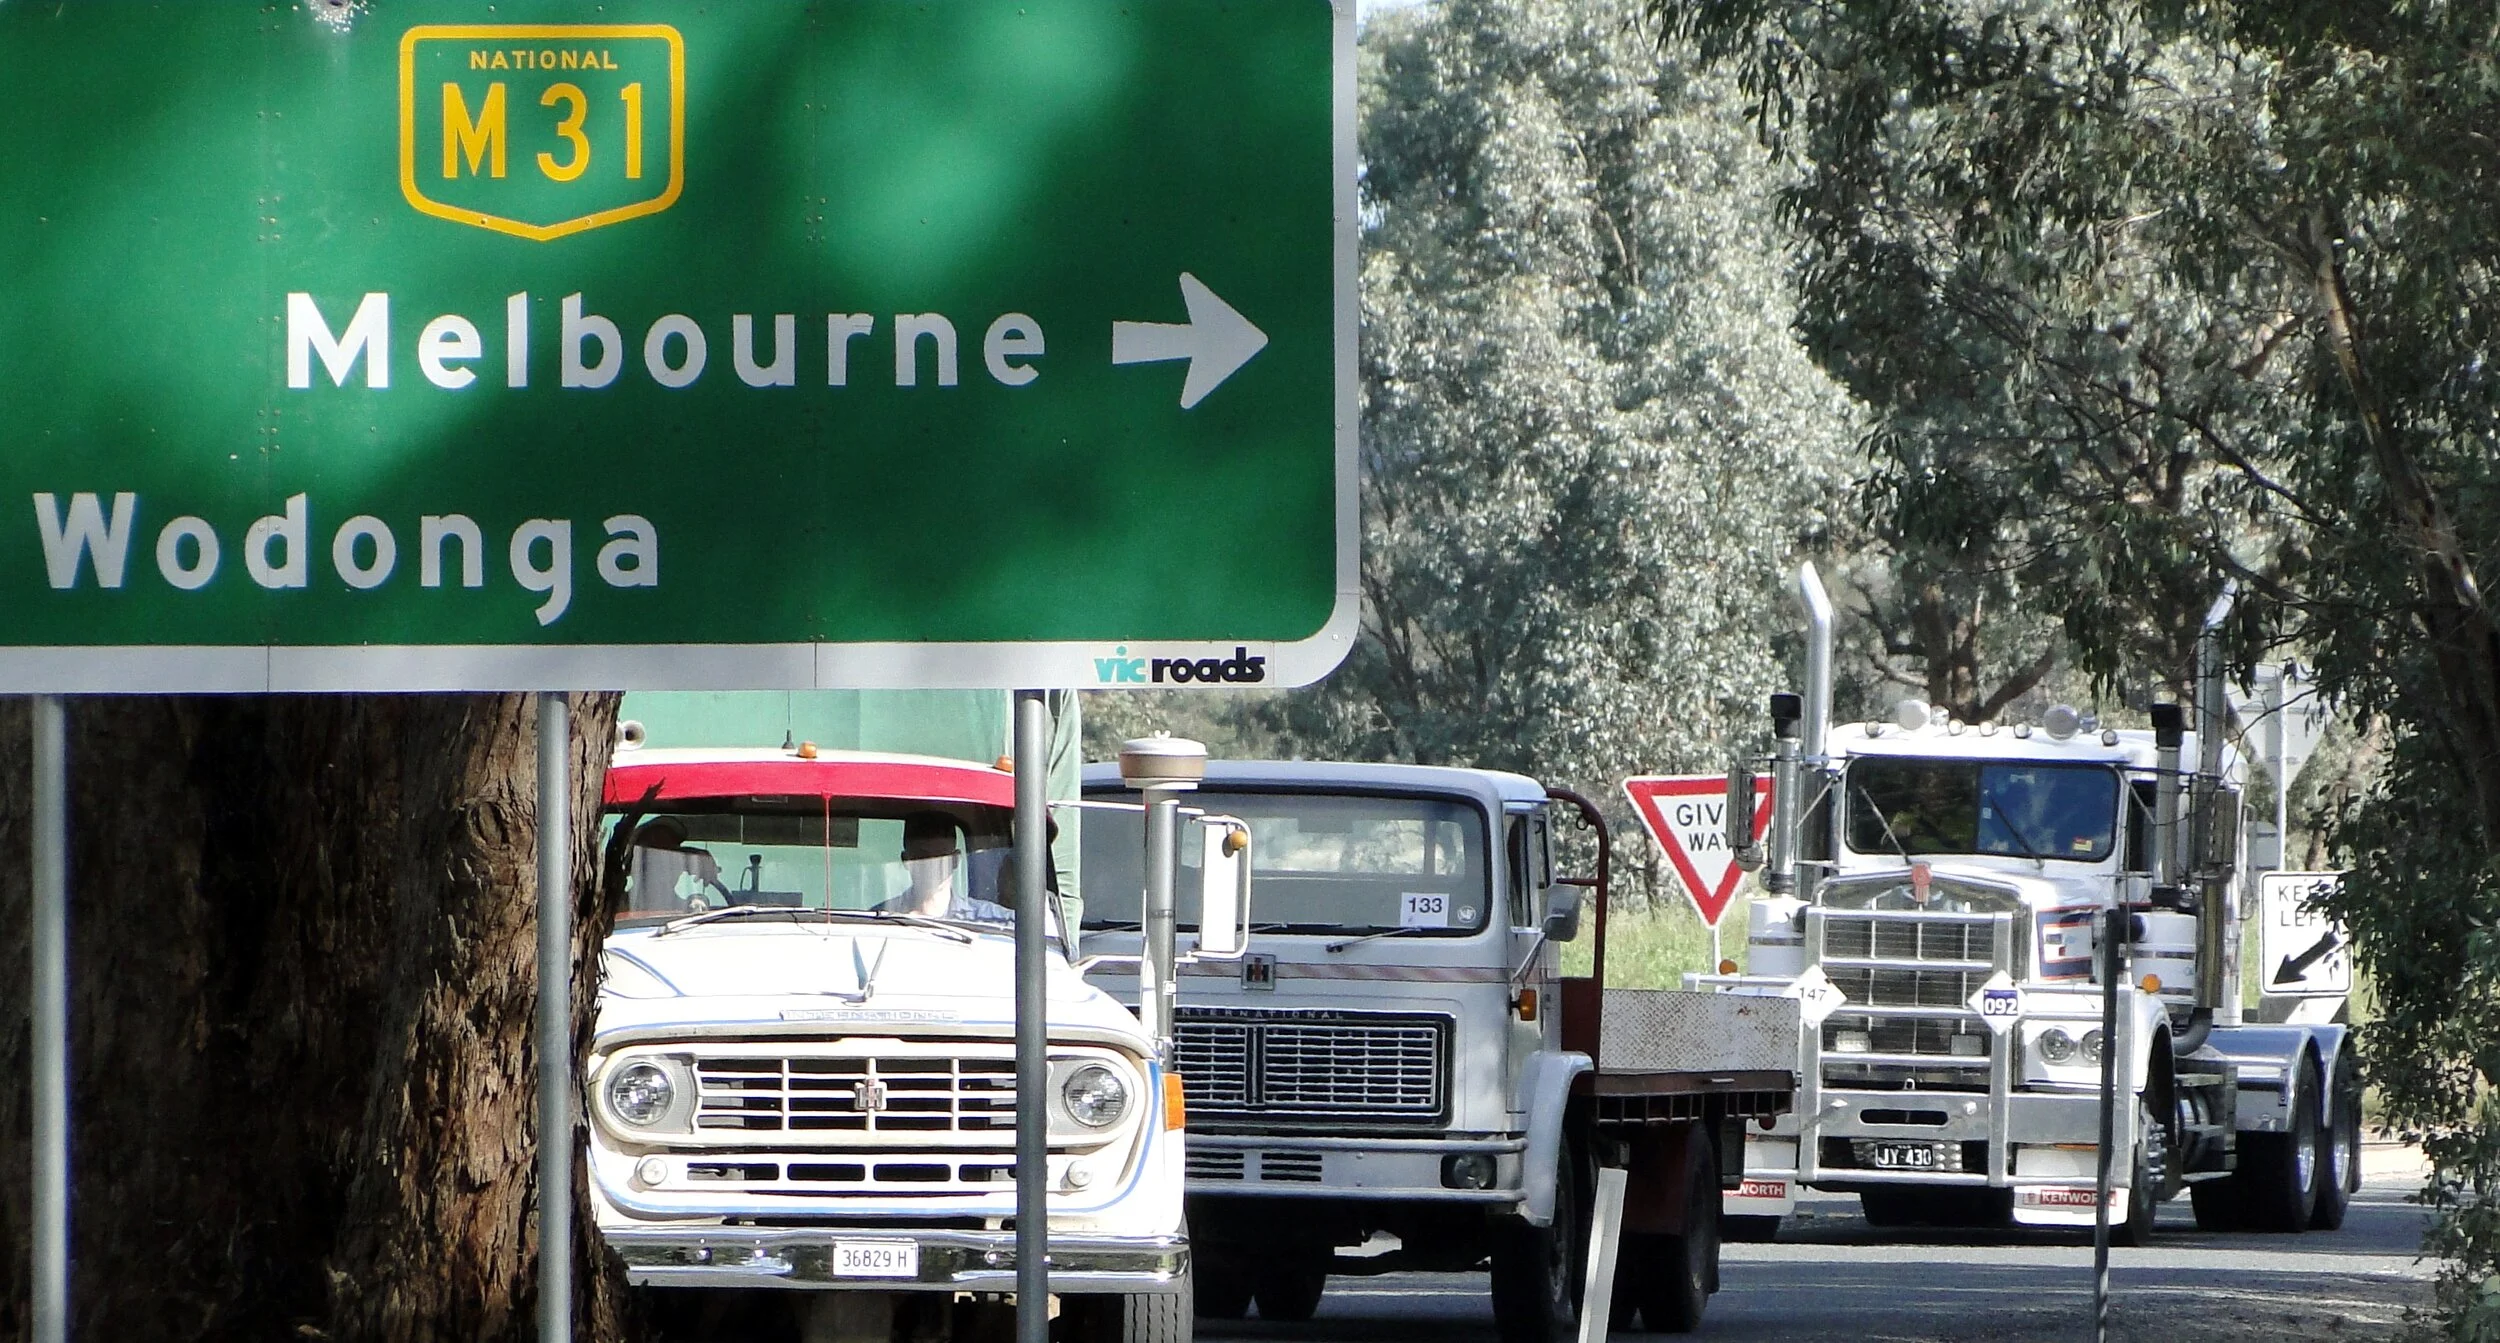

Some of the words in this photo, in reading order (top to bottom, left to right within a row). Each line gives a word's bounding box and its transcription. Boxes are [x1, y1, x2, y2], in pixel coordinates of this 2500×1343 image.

[470, 51, 618, 69] NATIONAL
[287, 290, 1046, 389] Melbourne
[33, 491, 659, 626] Wodonga
[1676, 803, 1724, 827] GIV
[1409, 897, 1443, 914] 133
[2280, 910, 2328, 927] LEF
[1799, 987, 1827, 1001] 147
[1181, 1008, 1344, 1020] NTERNATIONAL
[1984, 997, 2018, 1014] 092
[843, 1249, 892, 1268] 36829
[897, 1250, 907, 1268] H
